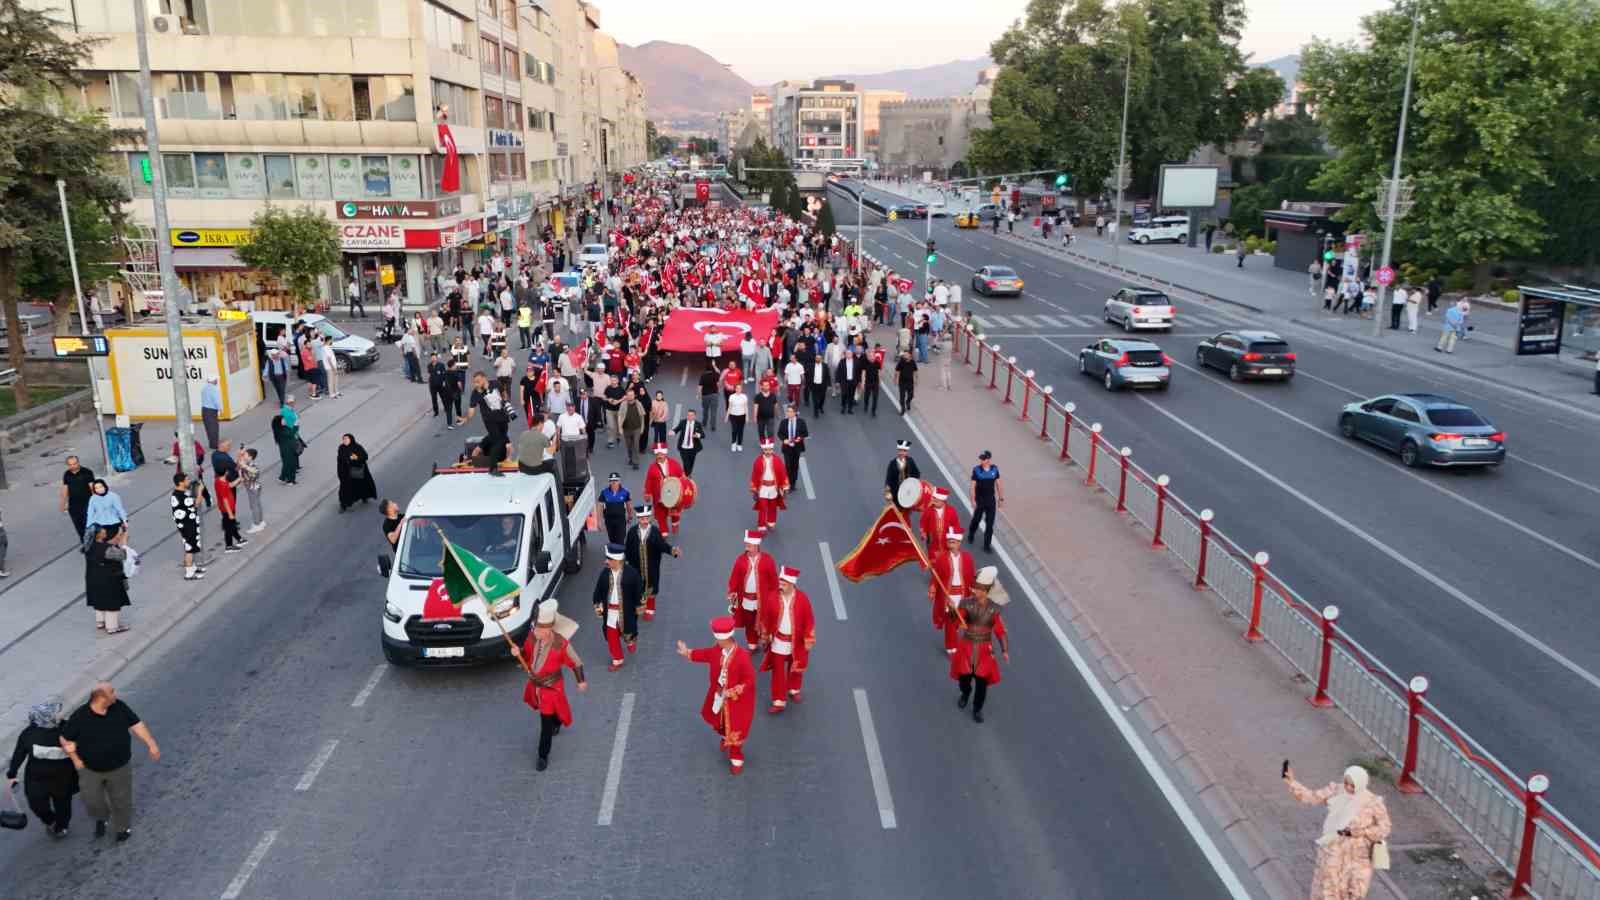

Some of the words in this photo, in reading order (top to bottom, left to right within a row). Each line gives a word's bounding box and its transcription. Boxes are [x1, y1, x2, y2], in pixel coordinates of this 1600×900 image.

[143, 347, 169, 360] SUN
[182, 346, 209, 360] AKSİ
[156, 366, 203, 380] DUAĞI
